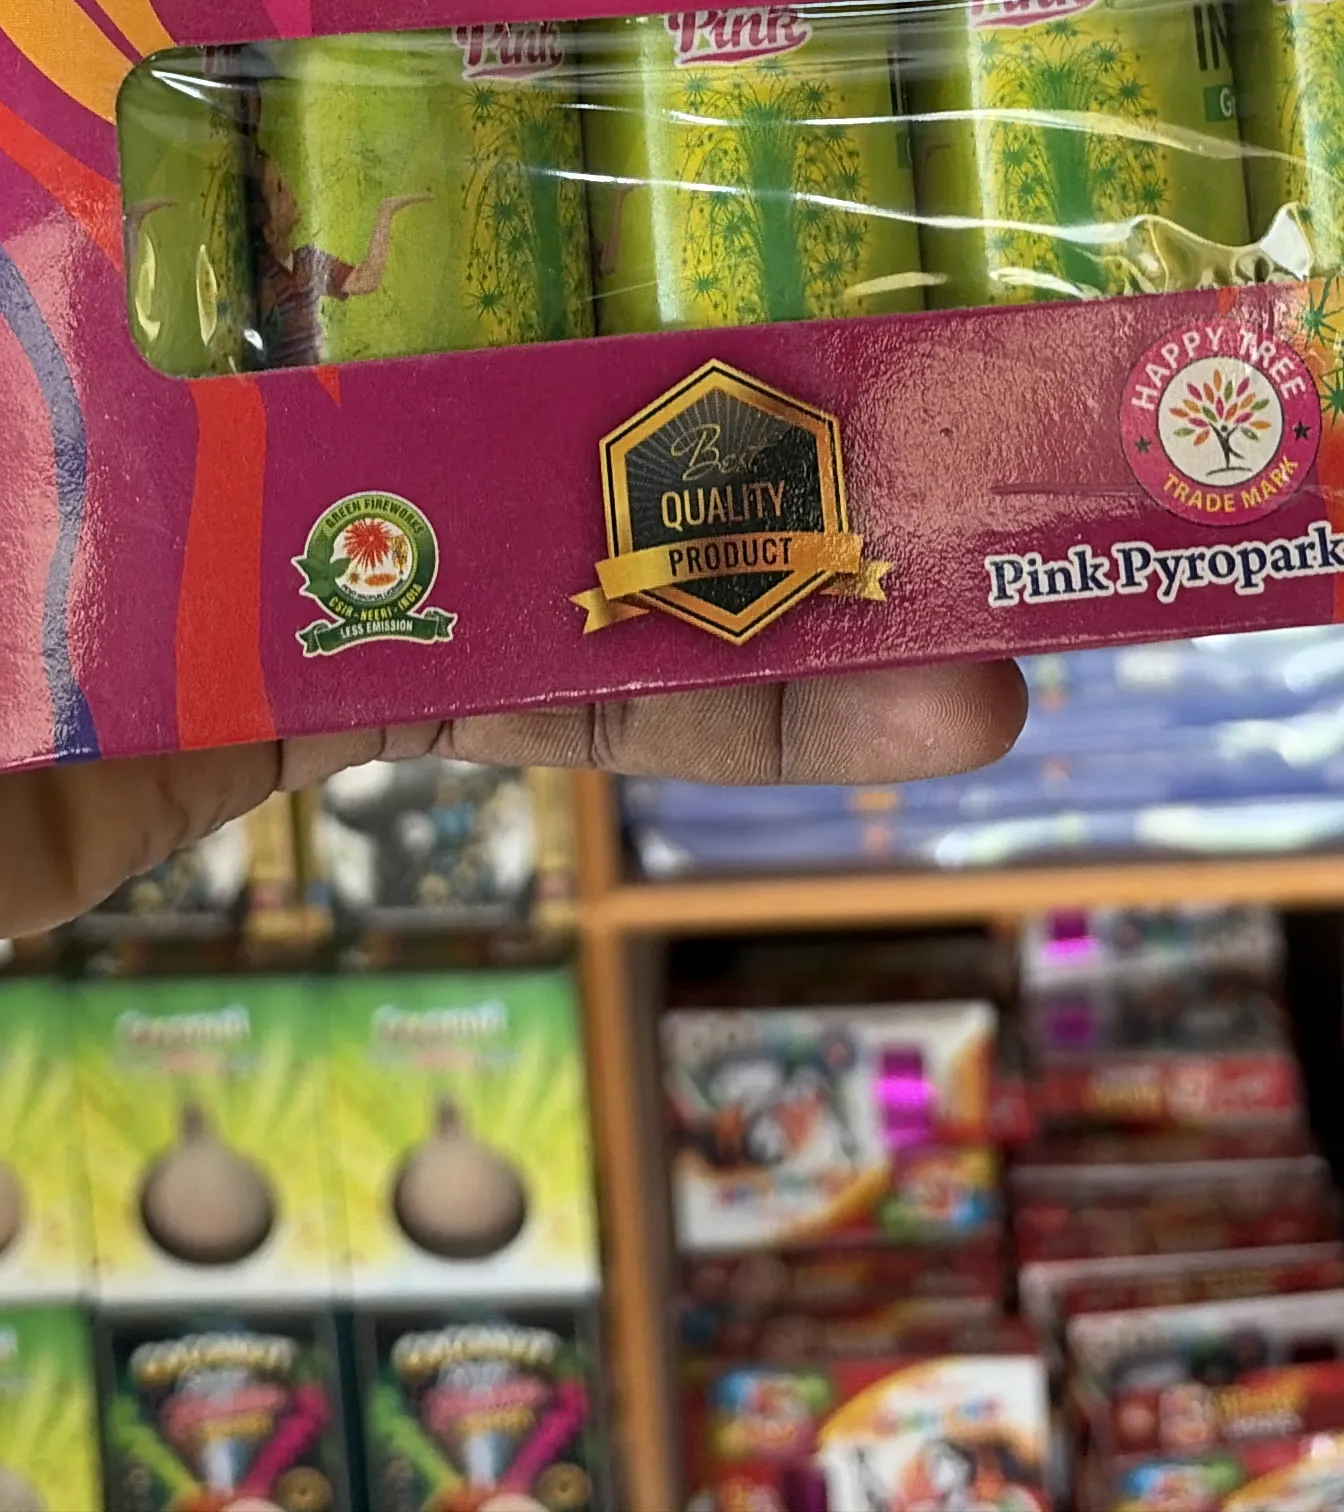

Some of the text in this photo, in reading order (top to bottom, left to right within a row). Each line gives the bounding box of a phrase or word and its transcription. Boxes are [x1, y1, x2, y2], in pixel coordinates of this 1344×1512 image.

[1131, 326, 1306, 411] HAPPY TREE
[660, 479, 785, 532] QUALITY
[1162, 455, 1300, 513] TRADE MARK
[324, 498, 425, 535] GREEN FIREWORKS
[668, 537, 793, 578] PRODUCT
[990, 550, 1117, 605] Pink
[340, 620, 414, 639] LESS EMISSION
